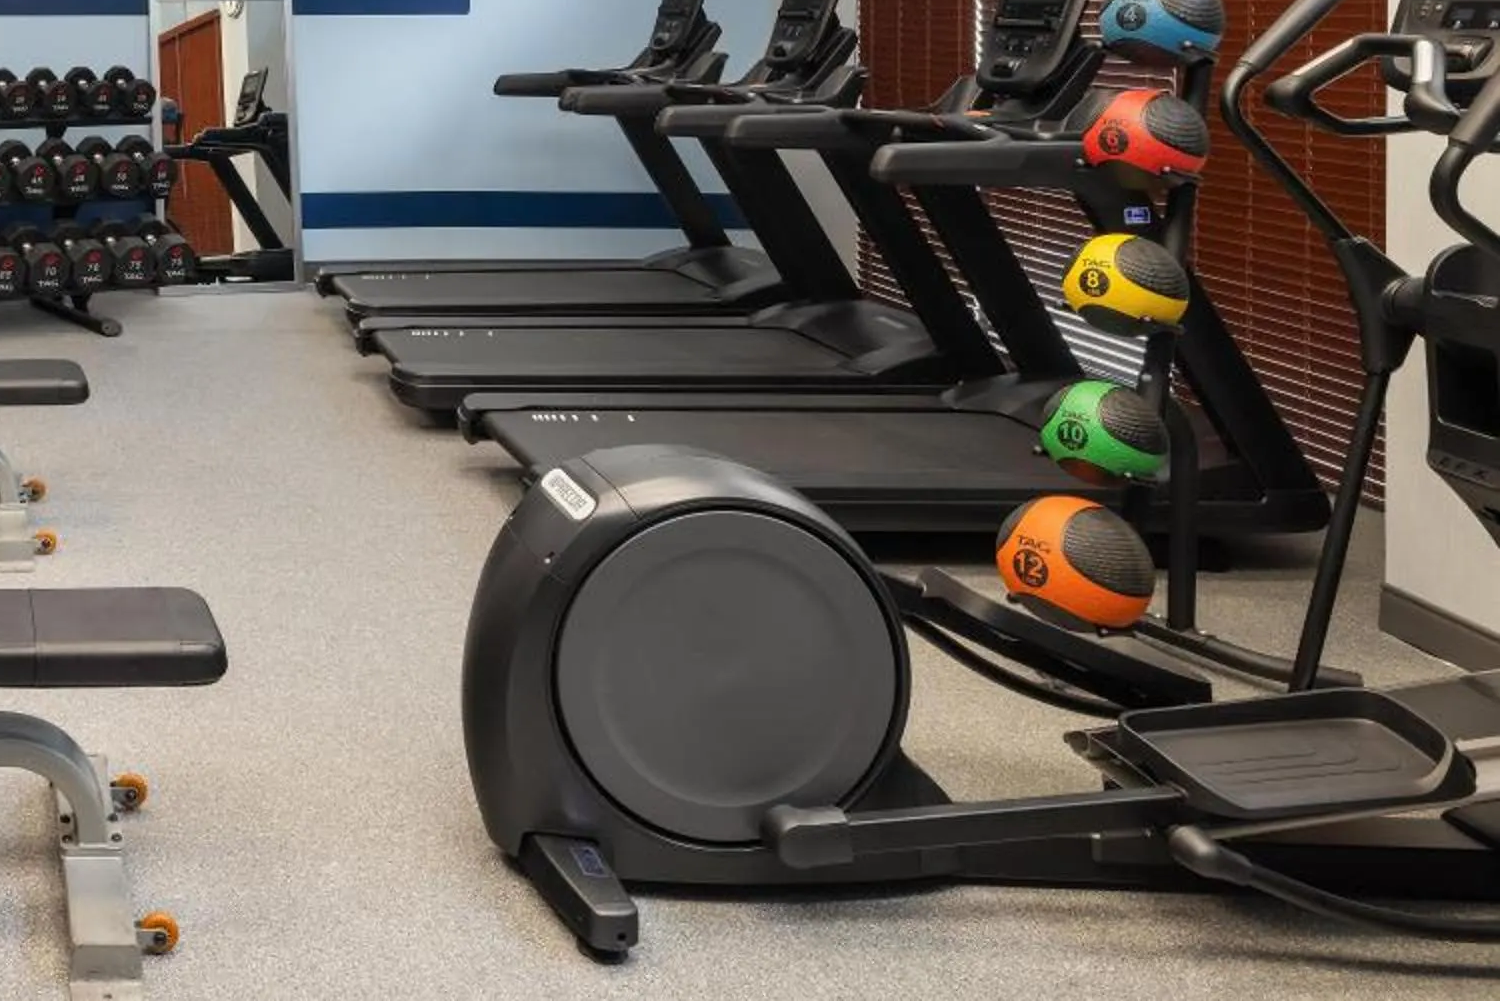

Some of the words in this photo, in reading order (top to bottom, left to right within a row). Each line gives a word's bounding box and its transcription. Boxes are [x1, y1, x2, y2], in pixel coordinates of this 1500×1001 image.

[1123, 5, 1139, 24] 4
[1082, 258, 1112, 269] TAG
[1087, 270, 1099, 288] 8
[1060, 422, 1084, 443] 10
[1017, 534, 1051, 554] TAG
[1016, 552, 1043, 579] 12
